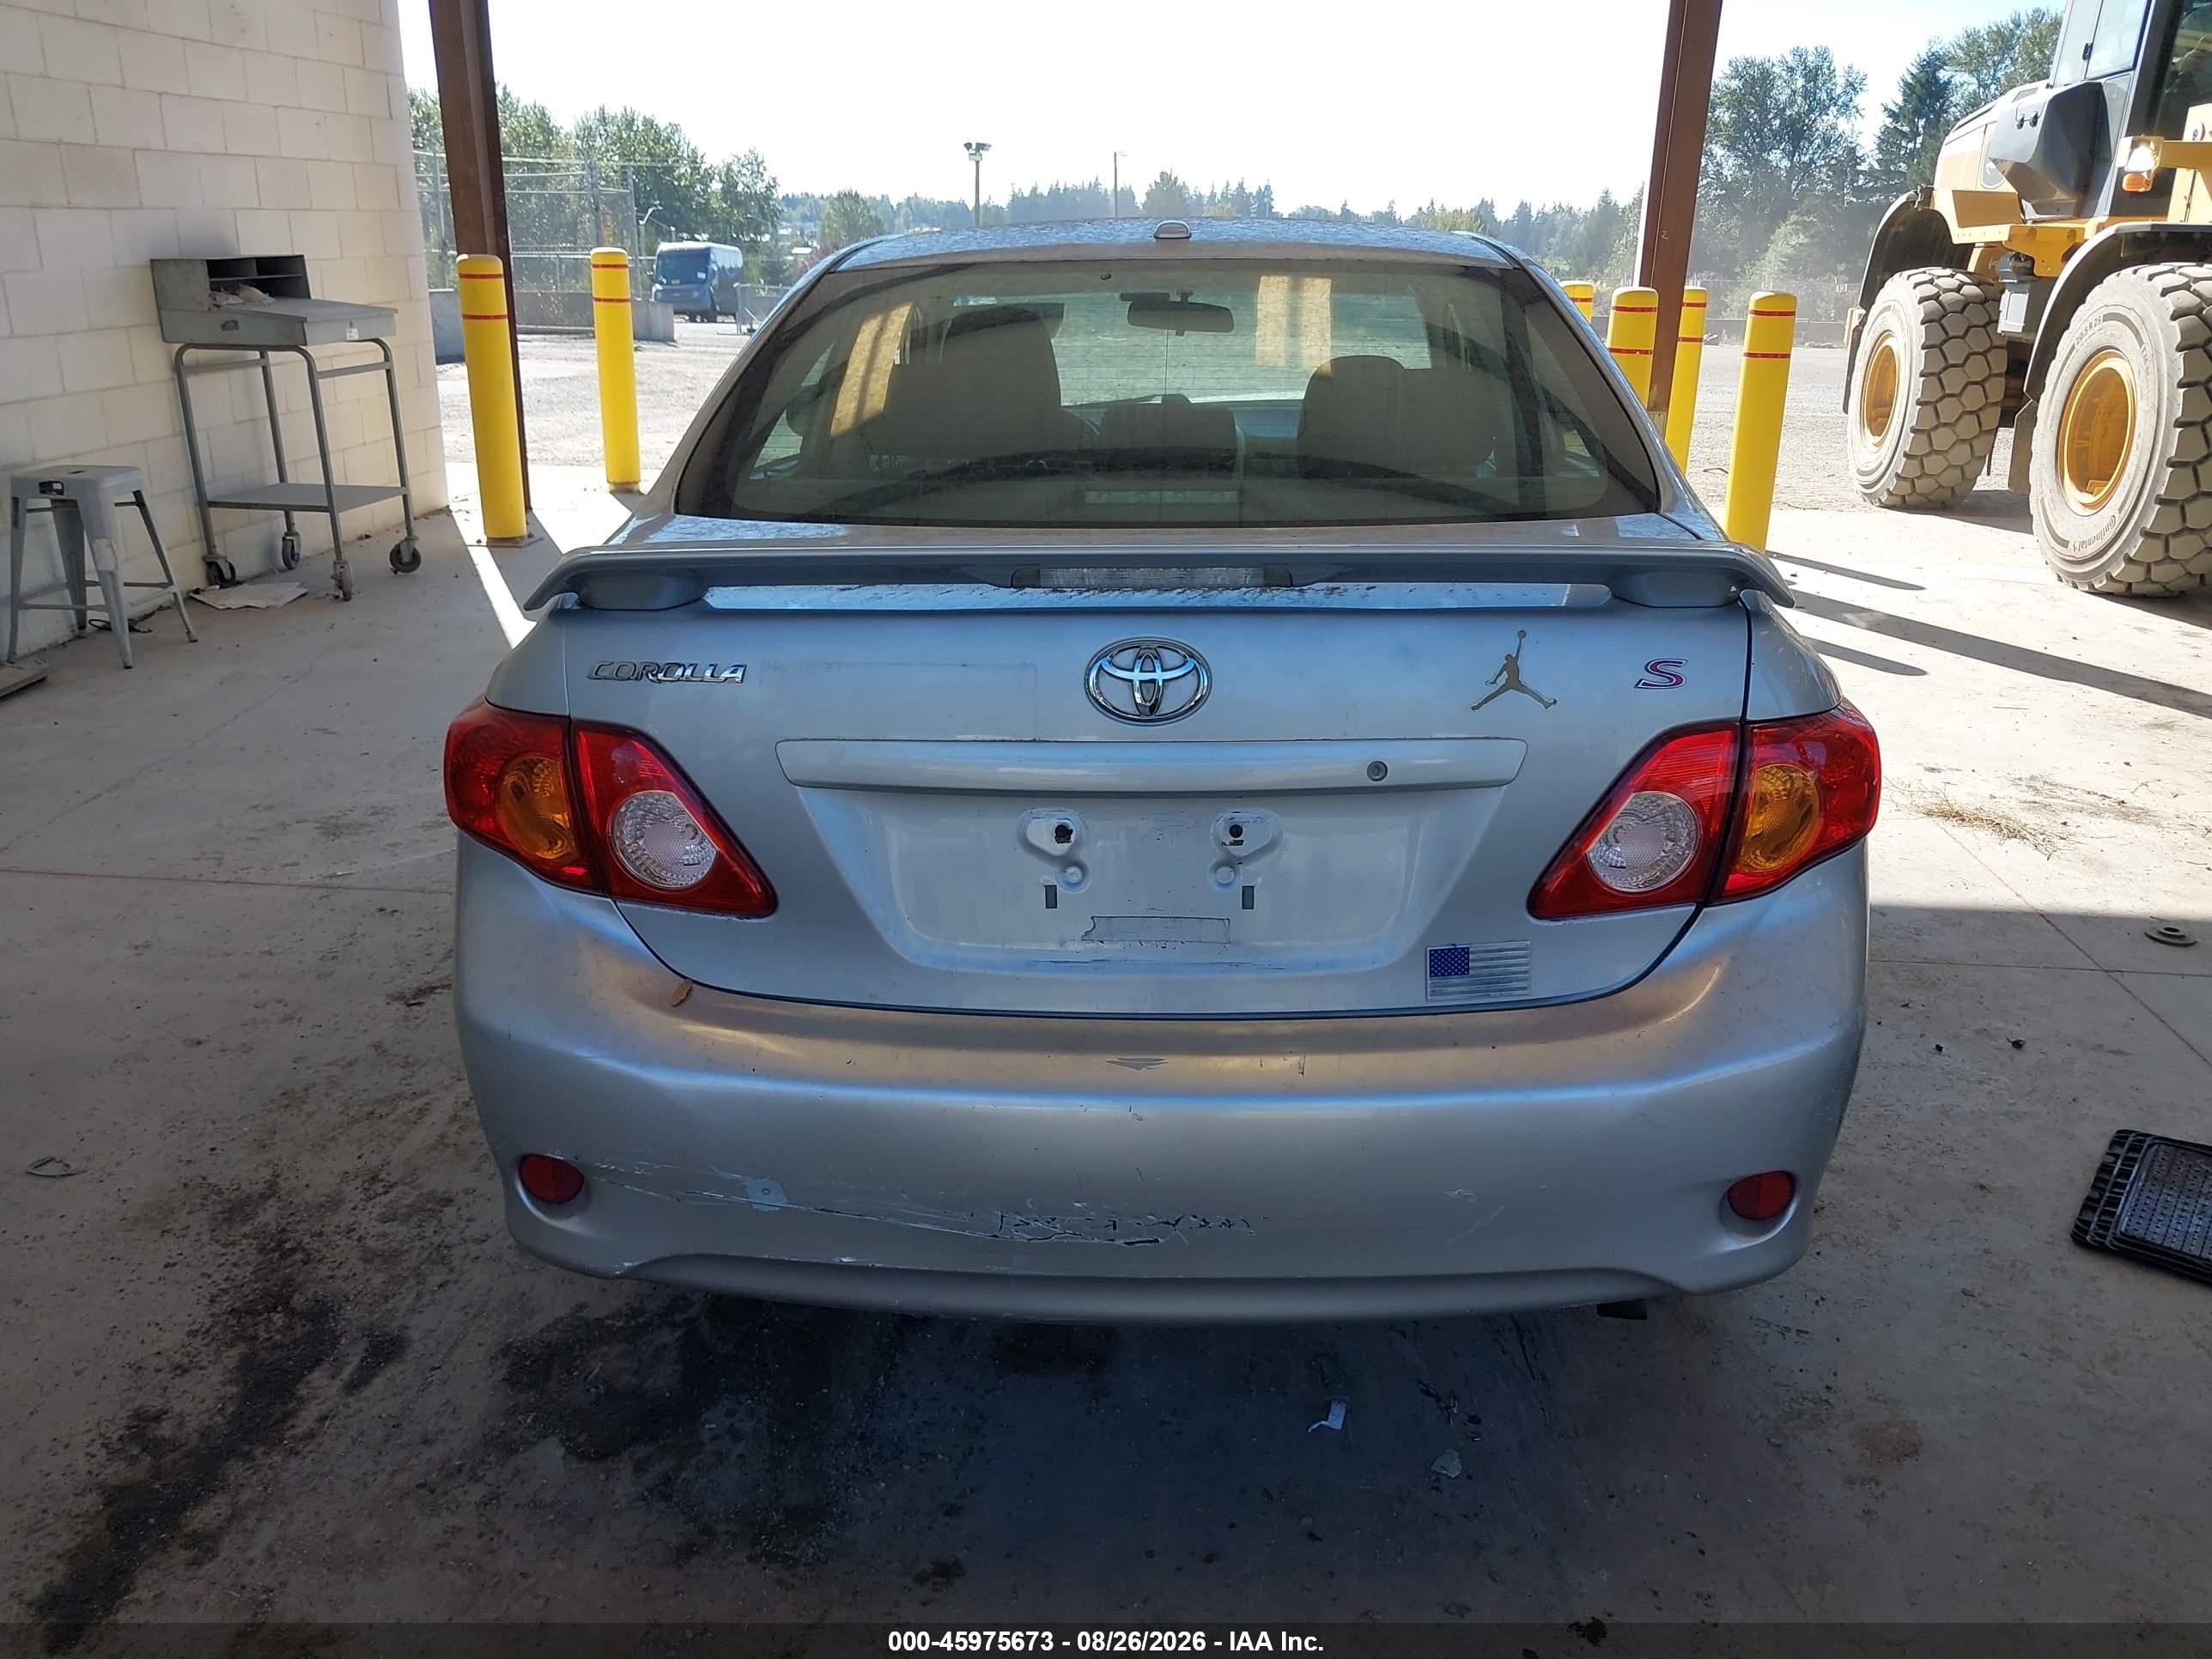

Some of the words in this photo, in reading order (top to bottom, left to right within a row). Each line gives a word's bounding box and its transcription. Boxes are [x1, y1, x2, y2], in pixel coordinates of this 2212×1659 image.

[2078, 514, 2117, 552] Continental
[586, 660, 748, 684] COROLLA
[1633, 658, 1688, 690] S
